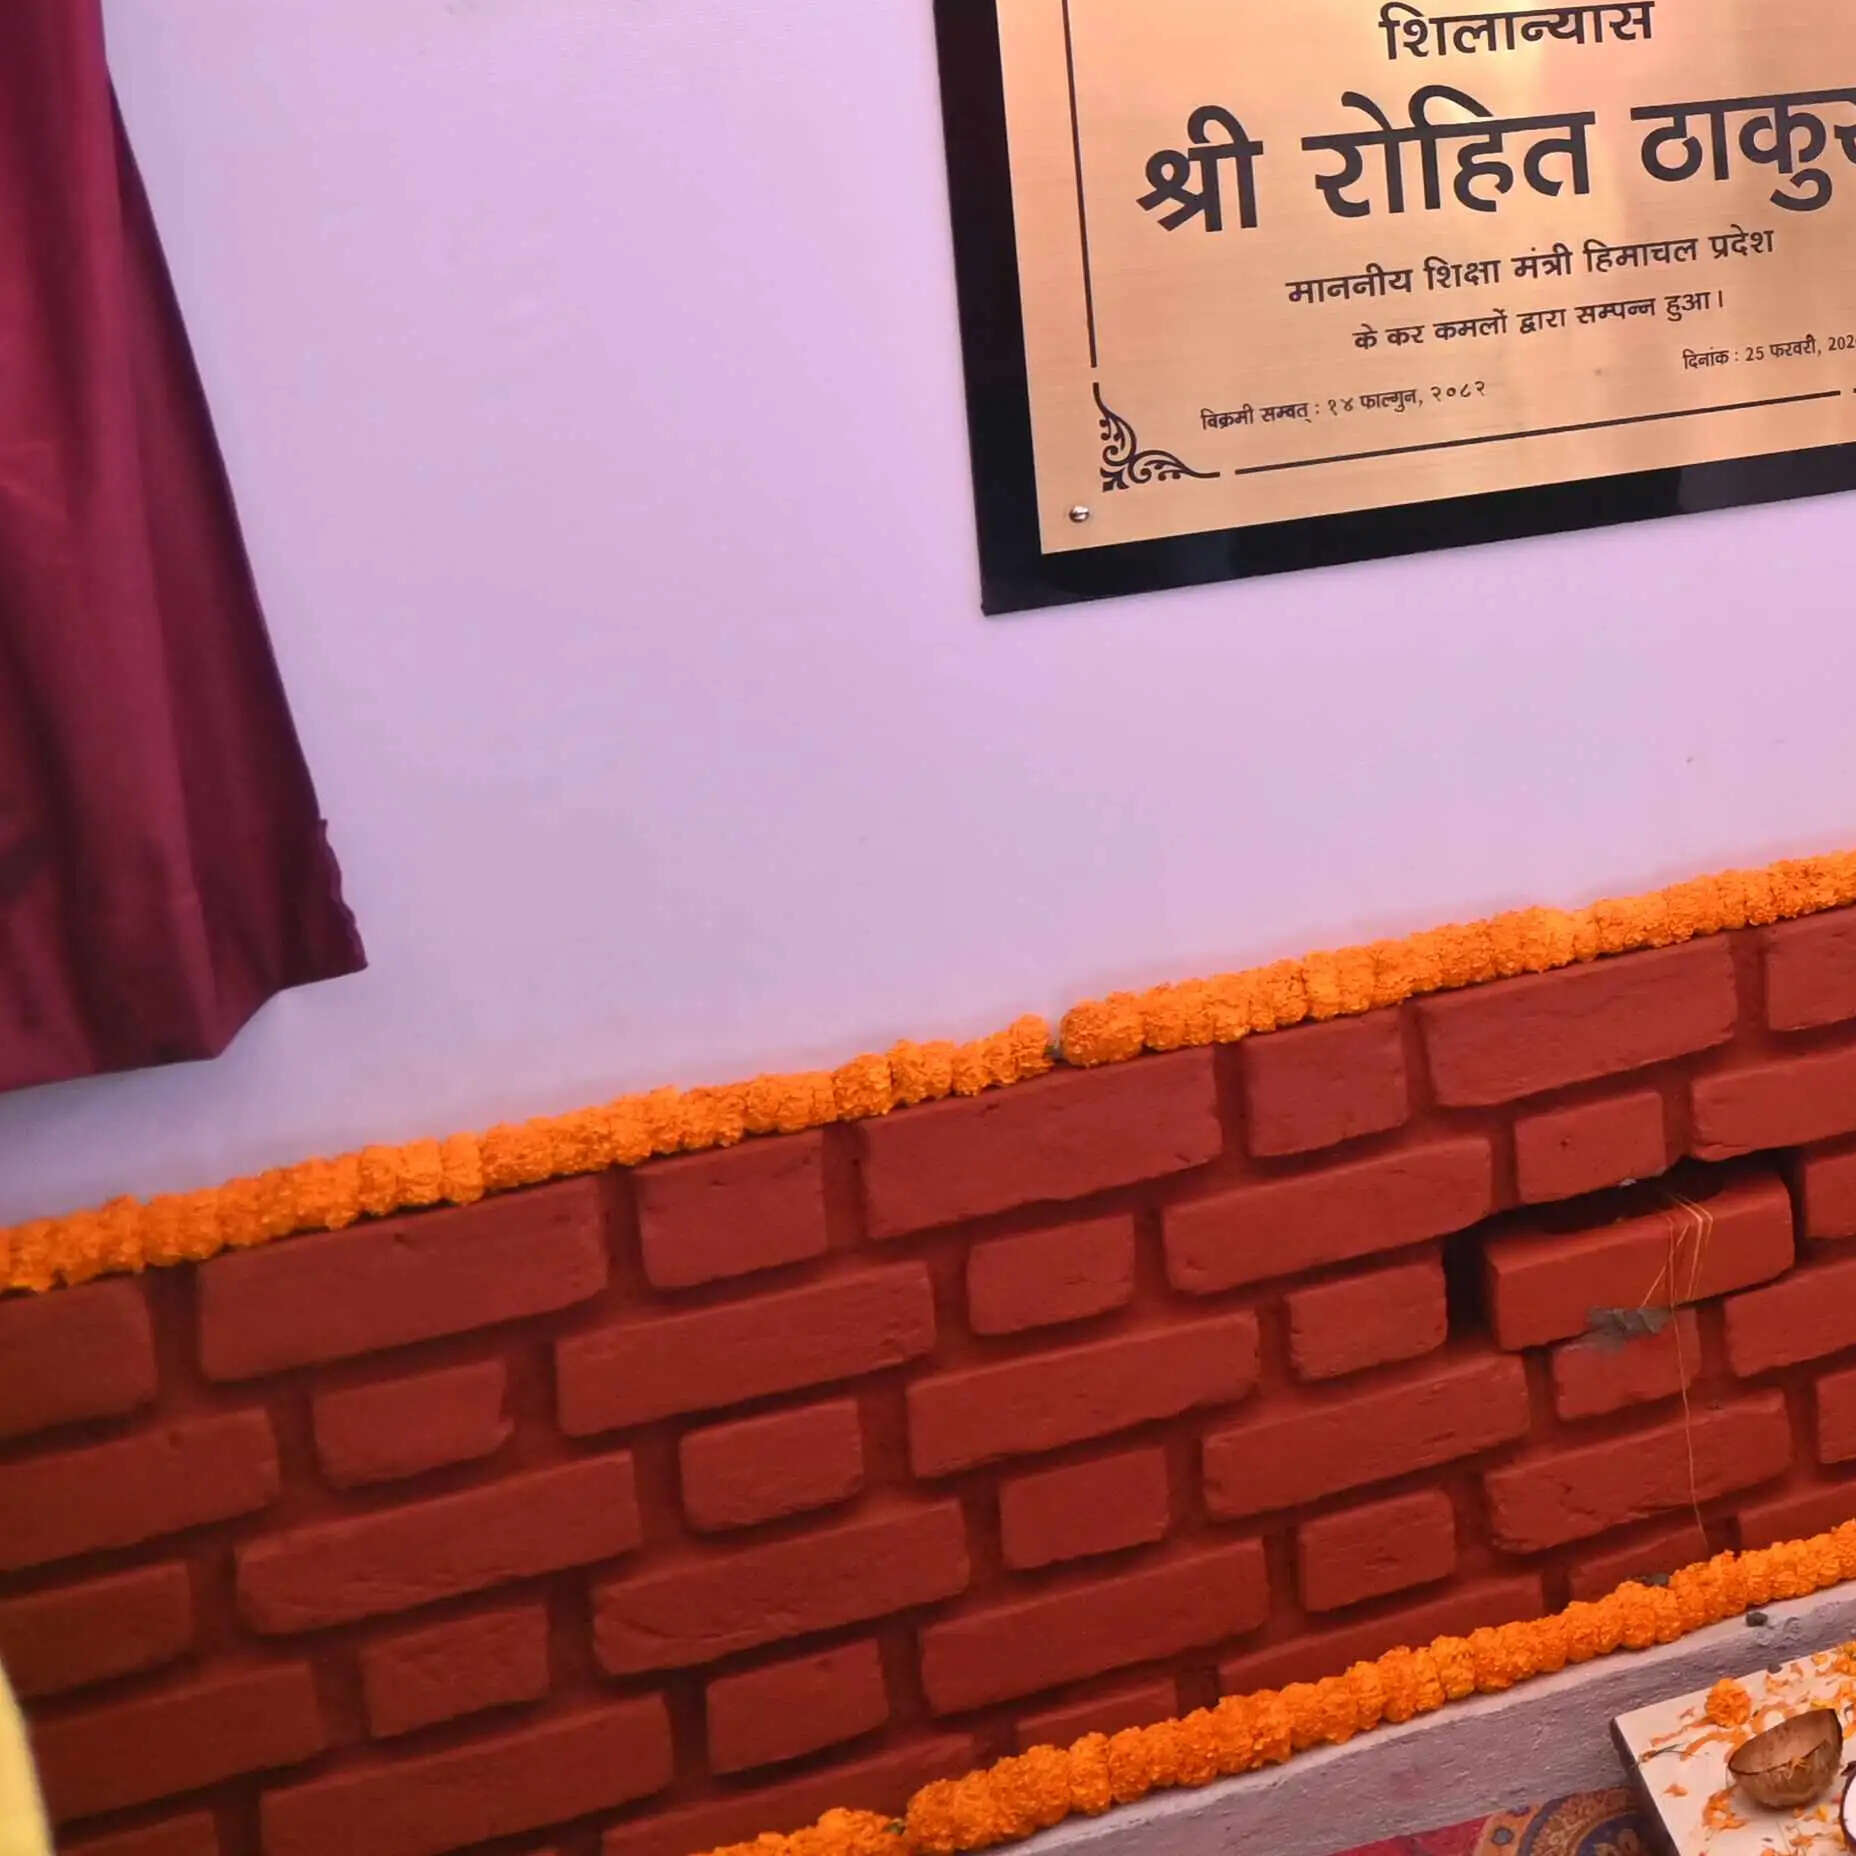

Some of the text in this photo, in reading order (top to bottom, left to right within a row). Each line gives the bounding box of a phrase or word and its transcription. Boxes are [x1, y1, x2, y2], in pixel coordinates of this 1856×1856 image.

[1377, 0, 1656, 61] शिलान्यास
[1136, 105, 1266, 234] श्री
[1302, 84, 1596, 218] रोहित
[1284, 223, 1775, 304] माननीय शिक्षा मंत्री हिमाचल प्रदेश
[1351, 322, 1379, 350] के
[1384, 324, 1426, 347] कर
[1432, 307, 1509, 341] कमलों
[1515, 308, 1568, 335] द्वारा
[1573, 297, 1657, 325] सम्पन्न
[1744, 345, 1765, 362] 25
[1768, 333, 1822, 359] फरवरी,
[1199, 403, 1255, 431] विक्रमी
[1327, 397, 1355, 417] १४
[1358, 388, 1424, 413] फाल्गुन,
[1430, 380, 1485, 402] २०८२
